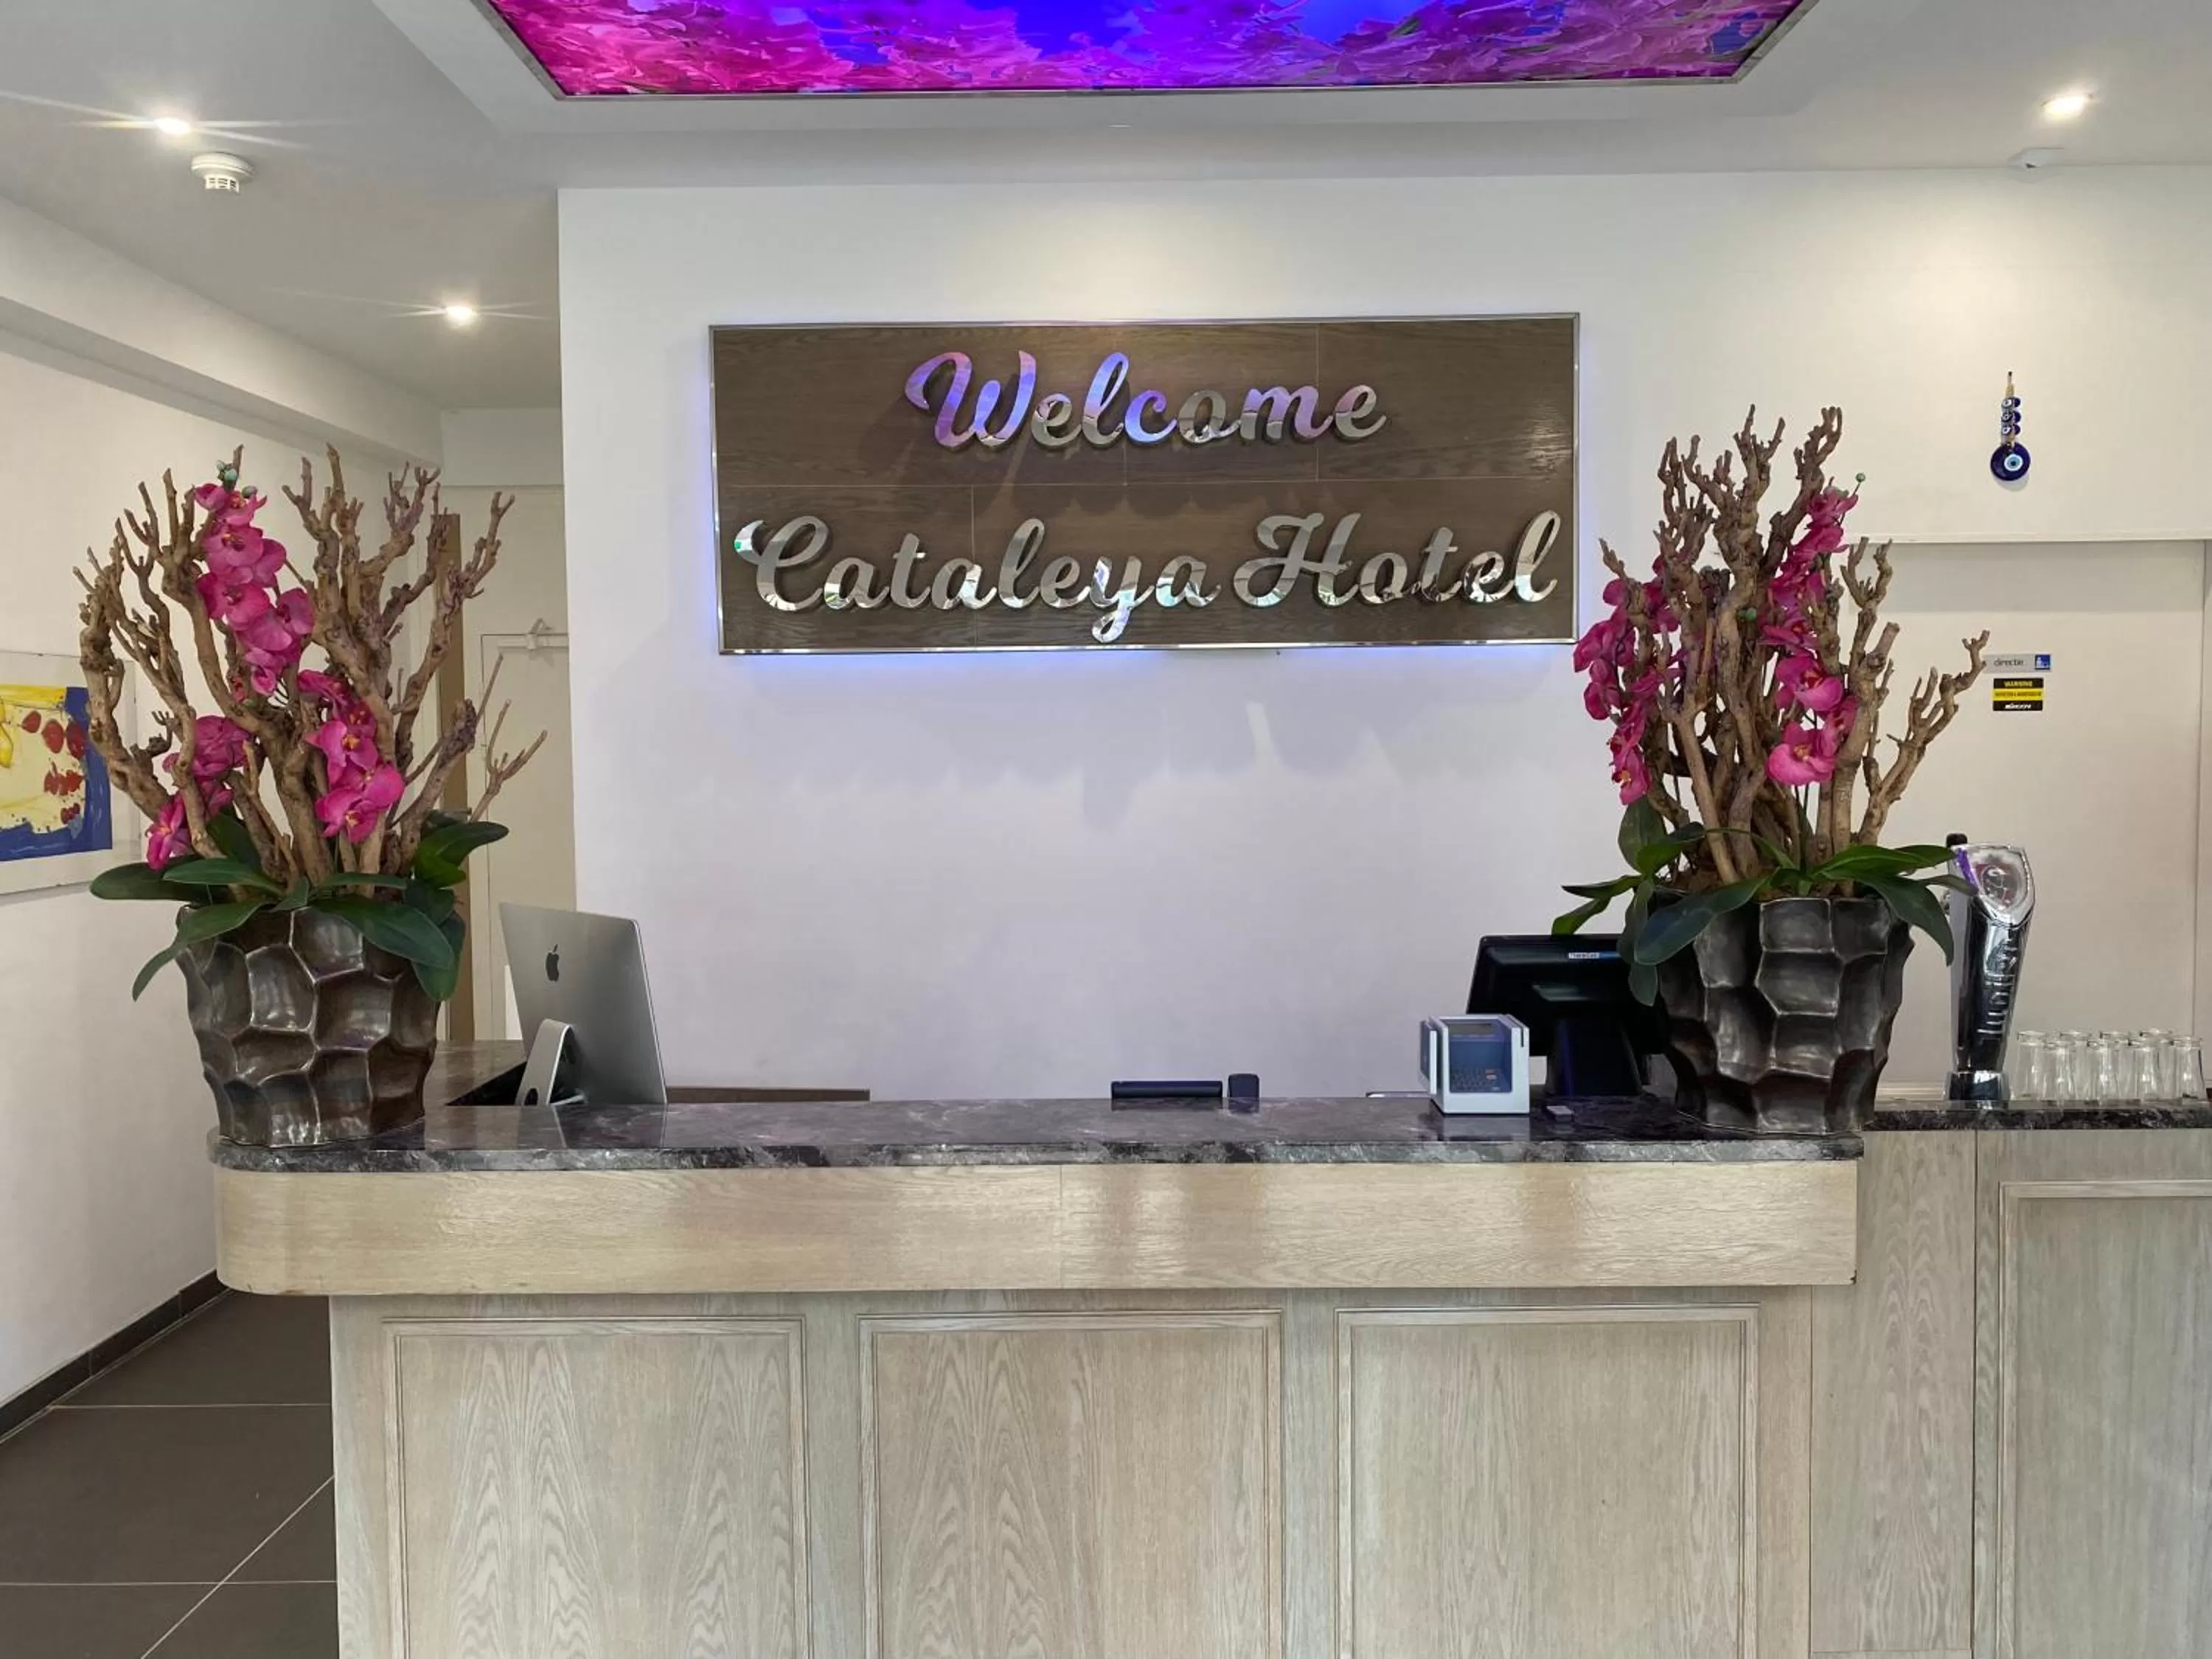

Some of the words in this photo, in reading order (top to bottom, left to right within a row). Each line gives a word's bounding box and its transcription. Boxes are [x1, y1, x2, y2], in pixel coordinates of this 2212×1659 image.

[905, 350, 1386, 447] Welcome
[735, 515, 1221, 644] Cataleya
[1232, 510, 1560, 608] Hotel
